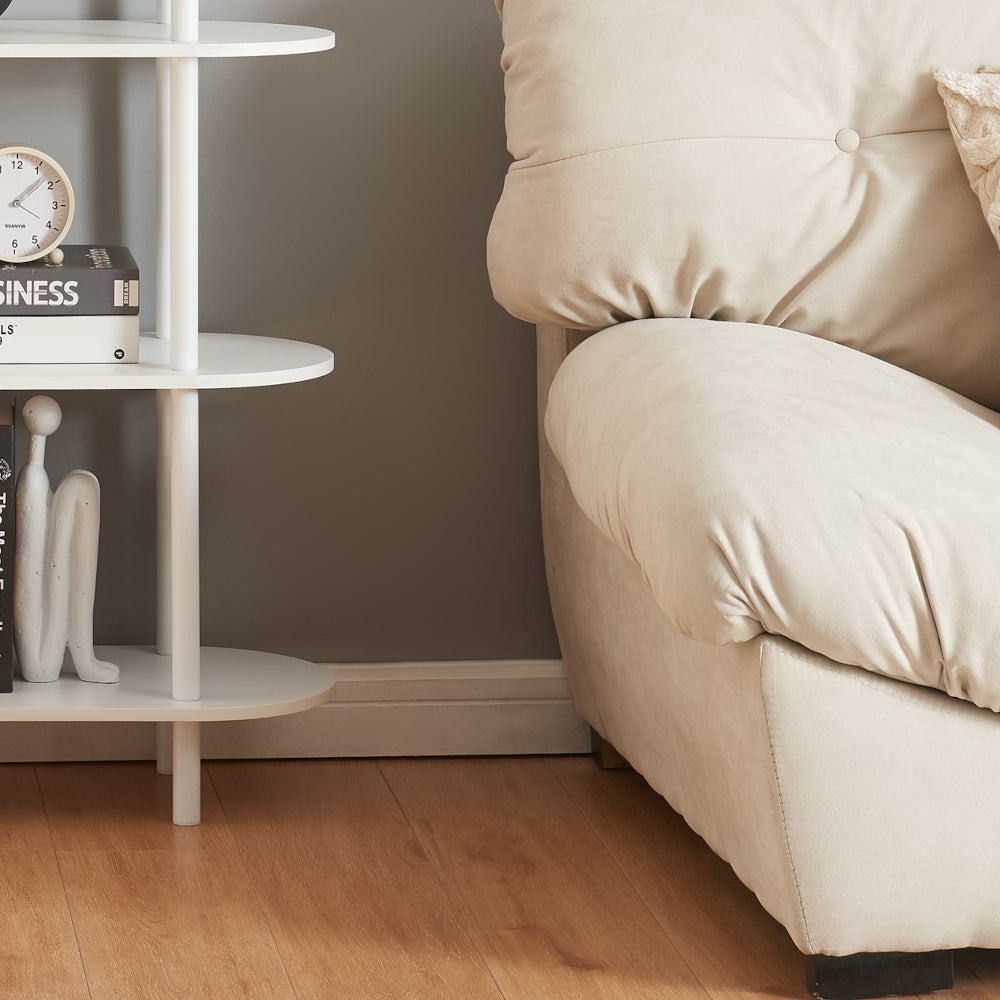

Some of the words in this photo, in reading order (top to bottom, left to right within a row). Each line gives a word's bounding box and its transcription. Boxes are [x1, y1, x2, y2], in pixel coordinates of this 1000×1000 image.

[11, 160, 23, 170] 12
[35, 167, 39, 175] 1
[47, 181, 54, 190] 2
[51, 201, 58, 210] 3
[45, 220, 52, 229] 4
[11, 239, 18, 248] 6
[31, 235, 38, 244] 5
